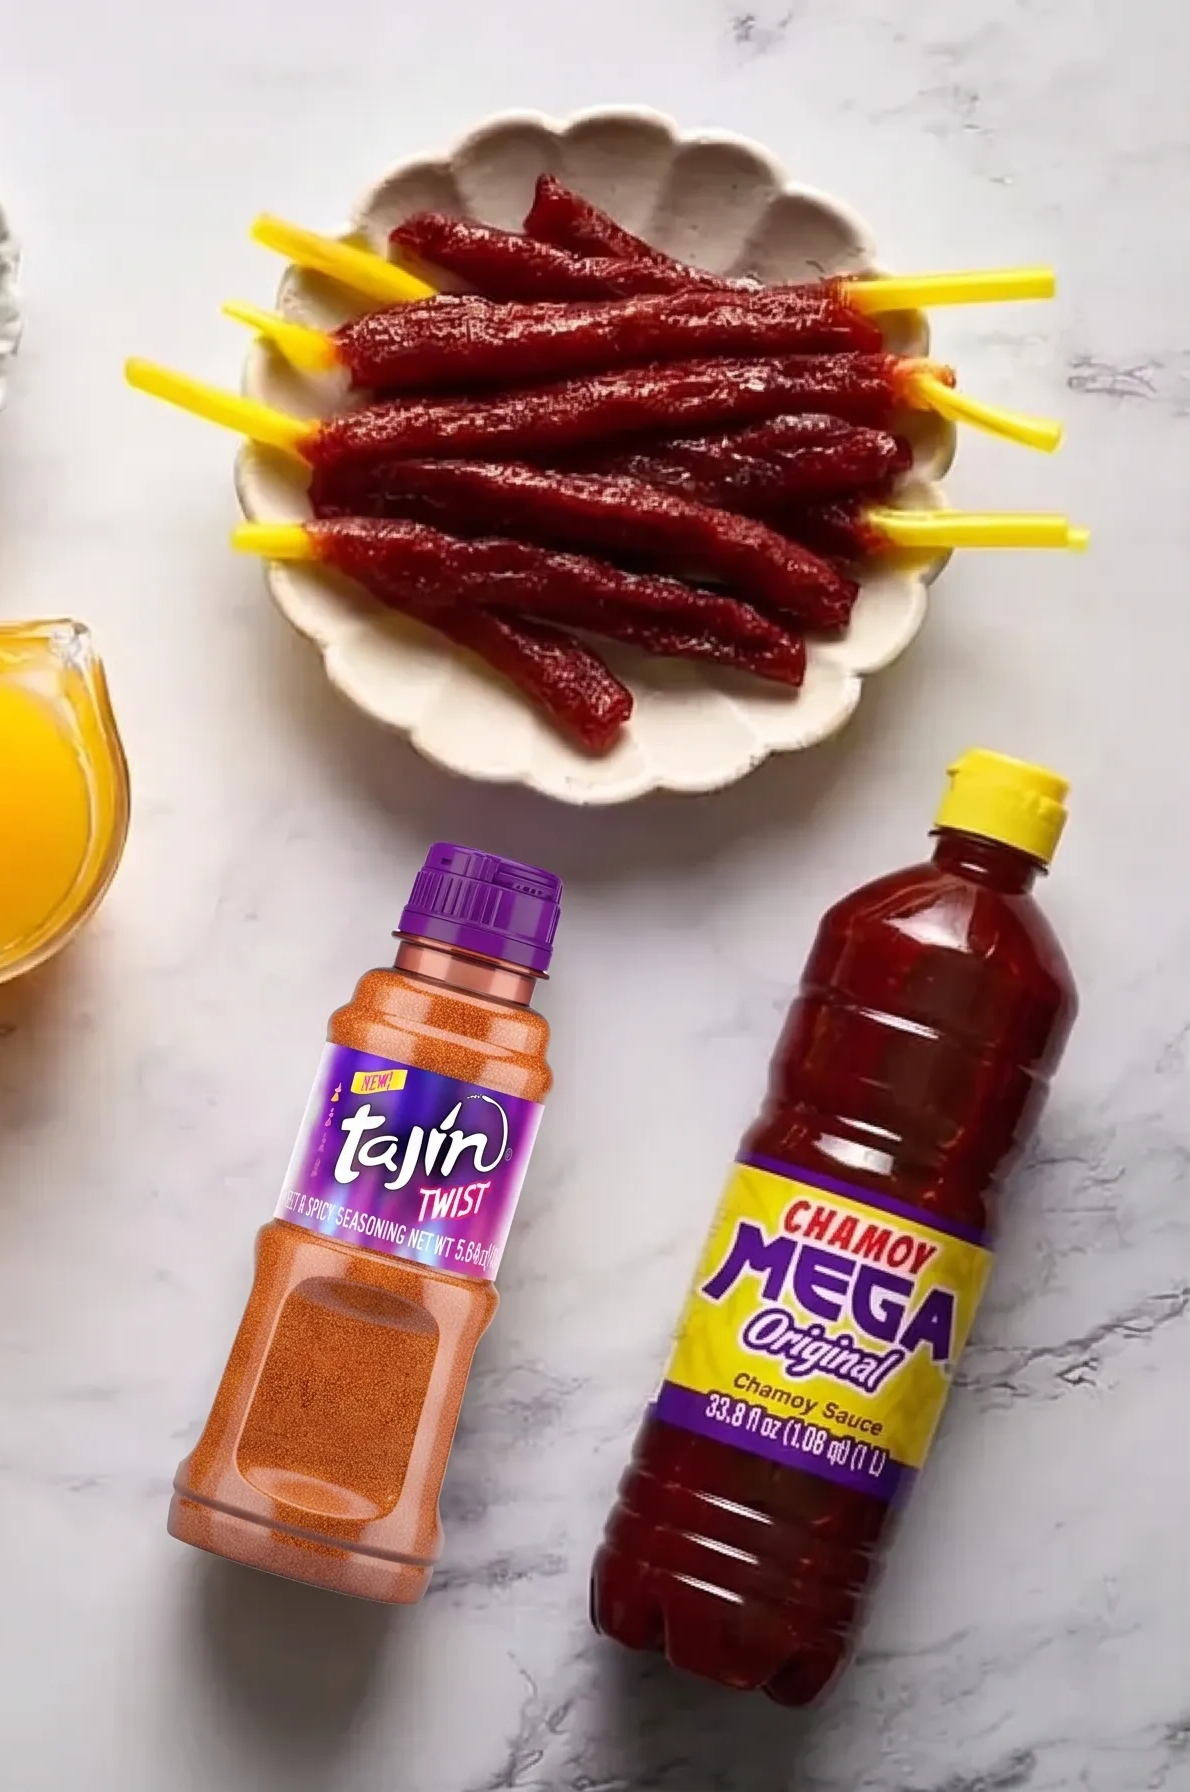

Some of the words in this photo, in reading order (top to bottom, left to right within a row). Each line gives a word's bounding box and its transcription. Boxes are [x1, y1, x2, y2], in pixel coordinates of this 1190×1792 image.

[361, 1071, 393, 1092] NEW!
[306, 1197, 336, 1222] SPICY
[336, 1207, 406, 1245] SEASONING
[407, 1228, 434, 1252] NET
[434, 1235, 455, 1258] WT
[418, 1181, 491, 1222] TWIST
[784, 1200, 937, 1275] CHAMOY
[702, 1222, 955, 1361] MEGA
[743, 1308, 906, 1394] Original
[706, 1394, 746, 1426] 33.8
[746, 1407, 761, 1432] fl
[761, 1418, 782, 1440] oz
[783, 1419, 827, 1455] (1.08
[733, 1373, 818, 1416] Chamoy
[822, 1401, 883, 1436] Sauce
